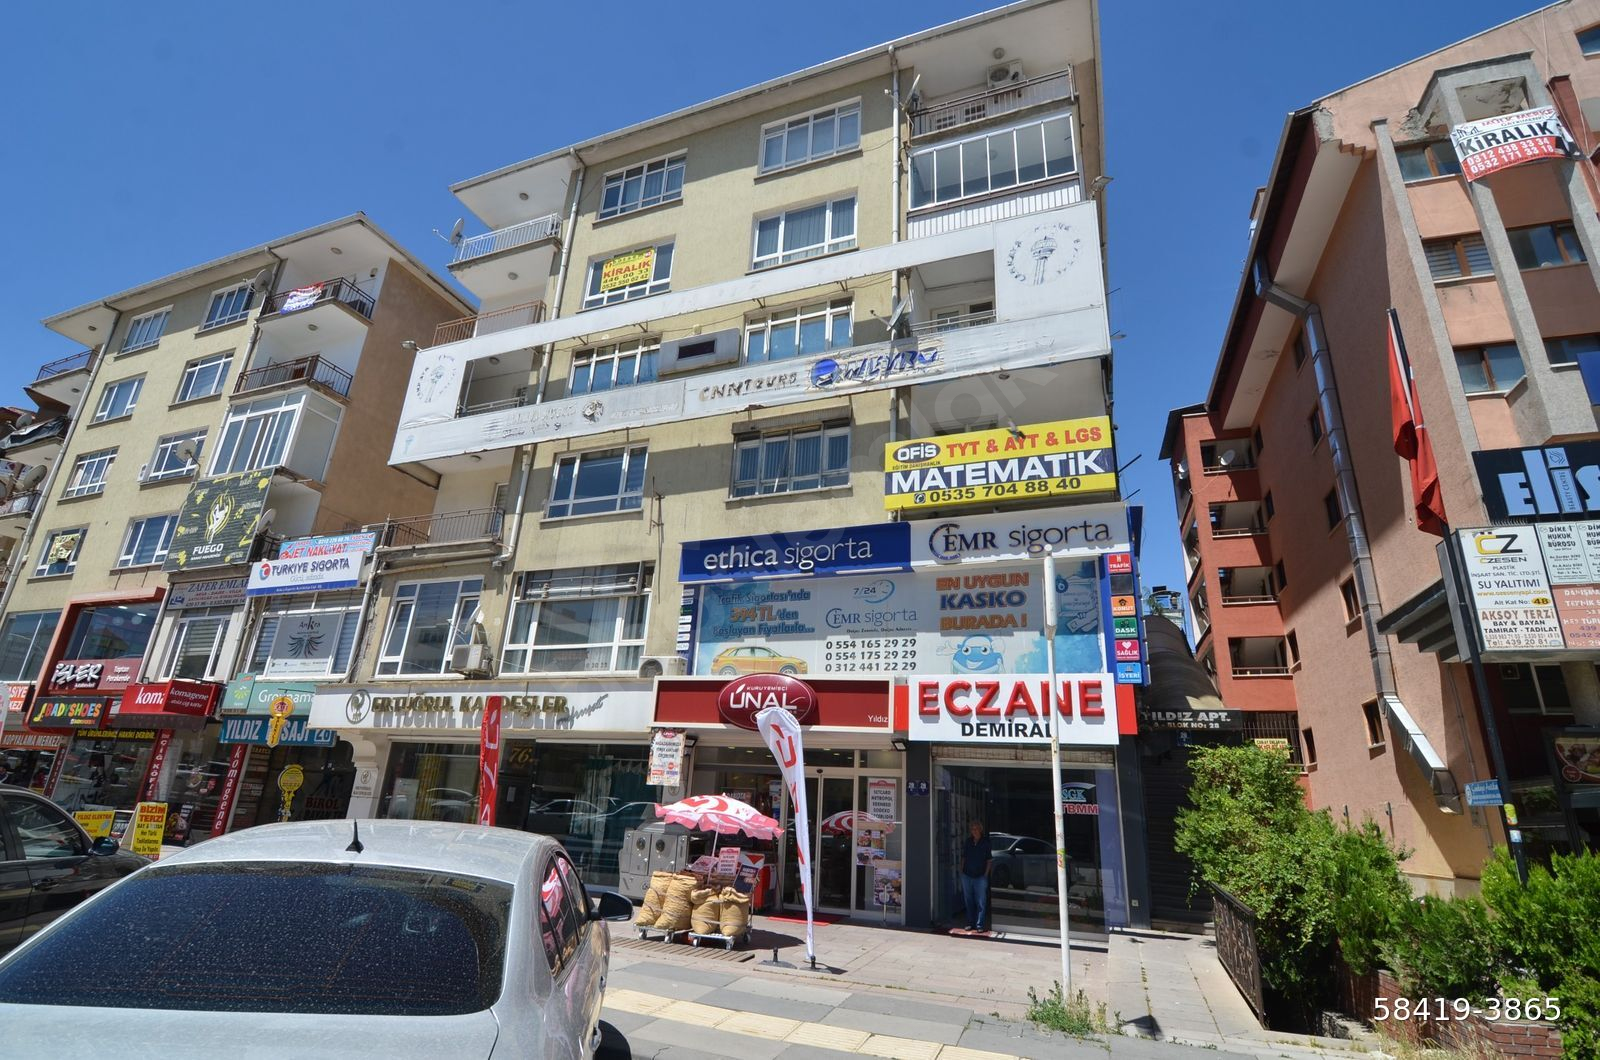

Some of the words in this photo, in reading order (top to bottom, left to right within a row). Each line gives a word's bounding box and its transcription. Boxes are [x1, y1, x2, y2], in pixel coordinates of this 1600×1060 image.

[1467, 150, 1495, 166] 0312
[1498, 144, 1519, 155] 438
[1521, 140, 1535, 149] 33
[1538, 137, 1550, 146] 34
[1470, 159, 1499, 174] 0532
[1502, 152, 1522, 163] 171
[1526, 148, 1539, 157] 33
[603, 260, 651, 279] KİRALIK
[603, 276, 620, 284] 446
[946, 441, 980, 458] TYT
[986, 439, 999, 453] &
[1004, 433, 1039, 451] AYT
[1045, 431, 1059, 446] &
[1064, 426, 1103, 444] LGS
[897, 443, 937, 461] OFİS
[891, 449, 1106, 494] MATEMATİK
[929, 486, 976, 503] 0535
[982, 483, 1018, 498] 704
[1024, 480, 1049, 493] 88
[1056, 477, 1081, 490] 40
[1008, 520, 1113, 554] sigorta
[192, 543, 224, 555] FUEGO
[703, 545, 779, 571] ethica
[784, 538, 873, 569] sigorta
[188, 581, 219, 592] ZAFER
[936, 576, 961, 591] EN
[963, 571, 1030, 589] UYGUN
[1478, 580, 1491, 589] SU
[1494, 578, 1541, 589] YALITIMI
[853, 587, 877, 595] 7/24
[940, 589, 1027, 611] KASKO
[864, 608, 918, 627] sigorta
[940, 614, 1018, 631] BURADA
[1482, 610, 1519, 621] AKSOY
[825, 641, 833, 650] 0
[835, 640, 857, 650] 554
[859, 639, 881, 649] 165
[883, 639, 898, 648] 29
[902, 638, 917, 647] 29
[1116, 647, 1139, 656] SAĞLIK
[825, 652, 833, 661] 0
[835, 652, 857, 661] 554
[859, 651, 881, 660] 175
[883, 650, 898, 660] 29
[902, 650, 917, 659] 29
[825, 664, 833, 673] 0
[835, 663, 857, 672] 312
[859, 663, 881, 672] 441
[883, 662, 898, 671] 22
[902, 662, 917, 671] 29
[169, 687, 209, 701] komagene
[918, 680, 1105, 717] ECZANE
[867, 714, 889, 724] Yıldız
[1141, 711, 1194, 721] YILDIZ
[1197, 711, 1232, 722] APT.
[226, 719, 263, 740] YILDIZ
[141, 804, 165, 814] BİZİM
[140, 814, 164, 823] TERZİ
